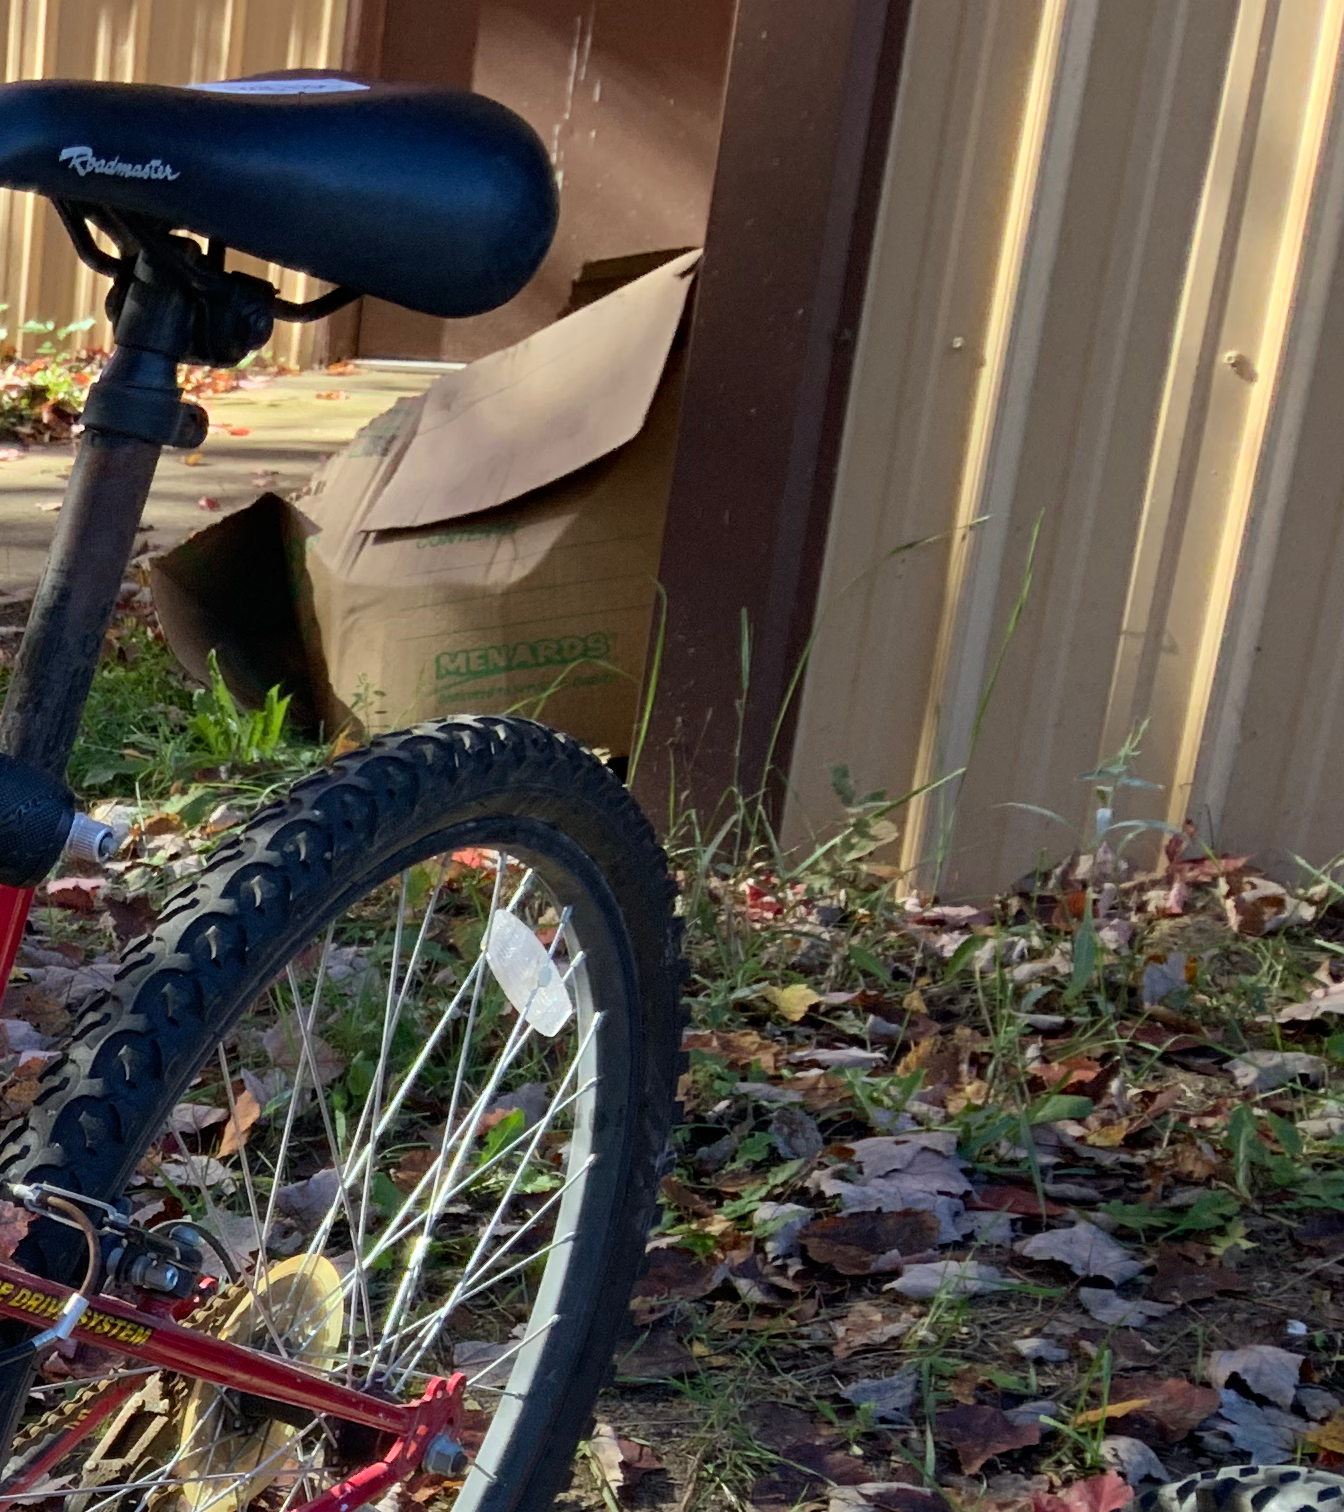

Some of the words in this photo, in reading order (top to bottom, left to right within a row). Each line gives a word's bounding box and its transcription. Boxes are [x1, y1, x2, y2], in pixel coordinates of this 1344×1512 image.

[58, 146, 181, 181] Roadmaster
[436, 633, 610, 680] MENARDS
[10, 1287, 67, 1321] DRIV
[76, 1307, 154, 1346] SYSTEM
